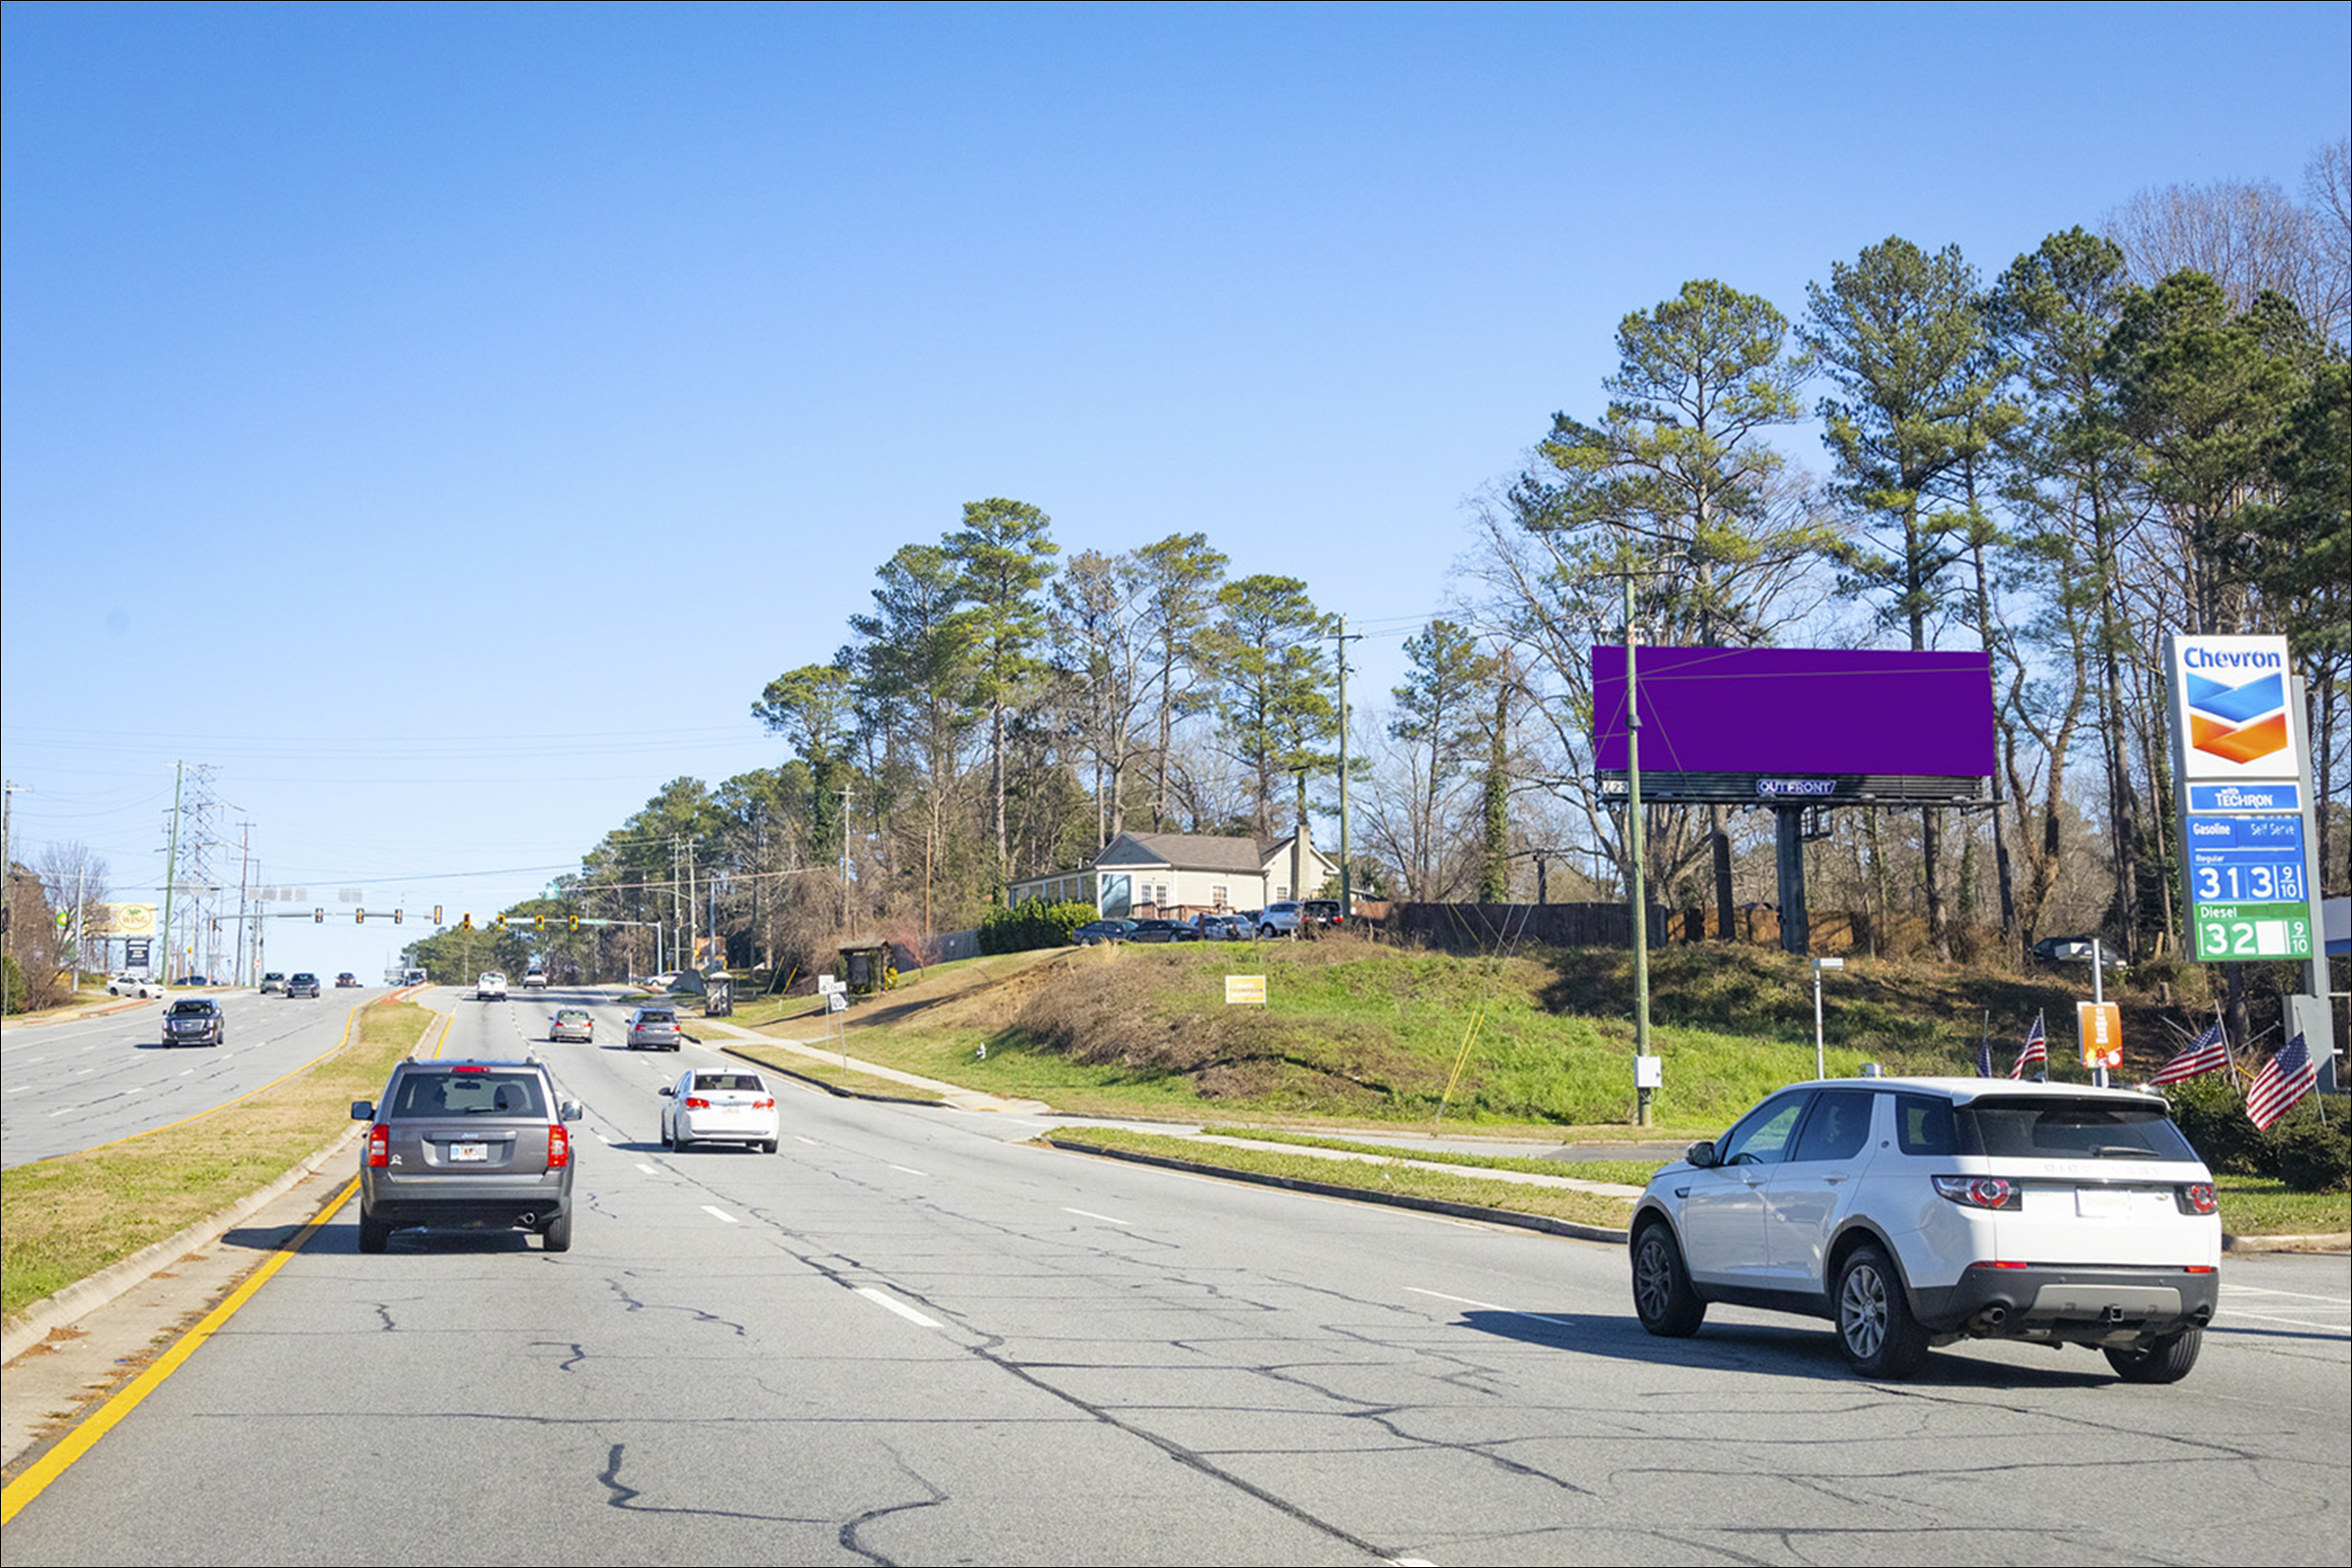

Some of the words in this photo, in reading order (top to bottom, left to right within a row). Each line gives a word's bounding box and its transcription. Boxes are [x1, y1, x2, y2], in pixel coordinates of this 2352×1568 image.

[2183, 647, 2281, 668] Chevron
[1759, 780, 1831, 794] OUTFRONT
[2215, 792, 2274, 809] TECHRON
[2192, 823, 2230, 836] Gasoline
[2195, 855, 2225, 864] Regular
[2281, 865, 2293, 881] 9
[2198, 866, 2274, 899] 313
[2280, 883, 2297, 898] 10
[2200, 906, 2237, 918] Diesel
[2293, 921, 2304, 936] 9
[2292, 939, 2308, 953] 10
